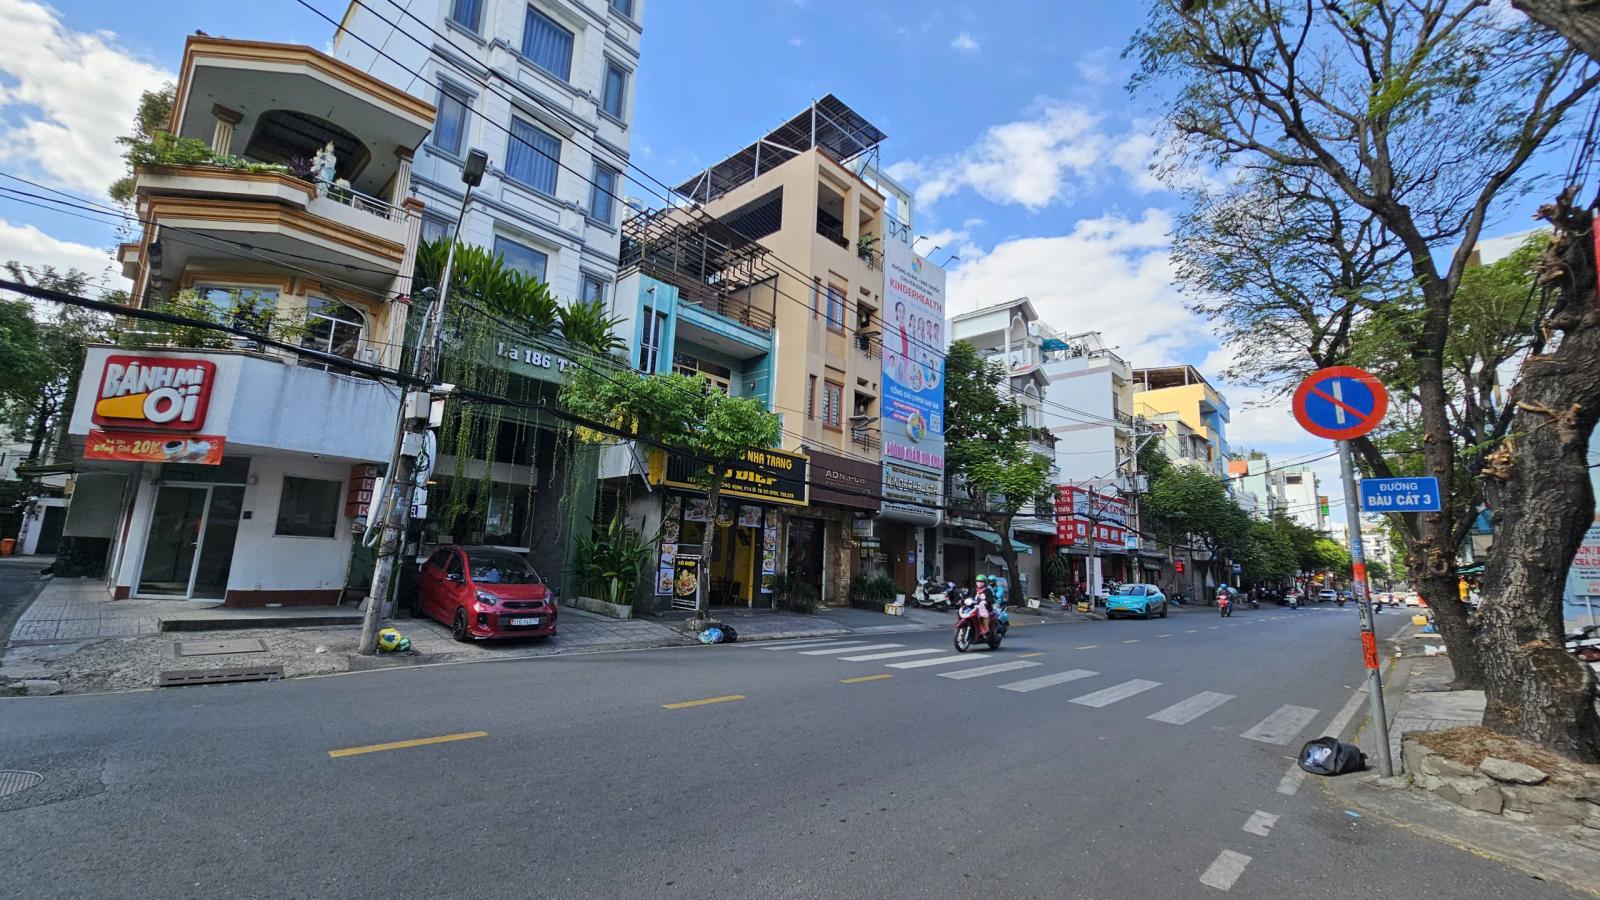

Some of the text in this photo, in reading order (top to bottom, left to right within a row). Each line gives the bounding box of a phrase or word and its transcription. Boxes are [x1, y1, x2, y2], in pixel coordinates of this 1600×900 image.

[889, 277, 942, 312] KINDERHEALTH
[525, 349, 551, 369] 186
[747, 450, 765, 465] NHA
[766, 454, 793, 470] TRANG
[1379, 480, 1418, 492] ĐƯỜNG
[1368, 491, 1432, 506] BÀU CÁT 3
